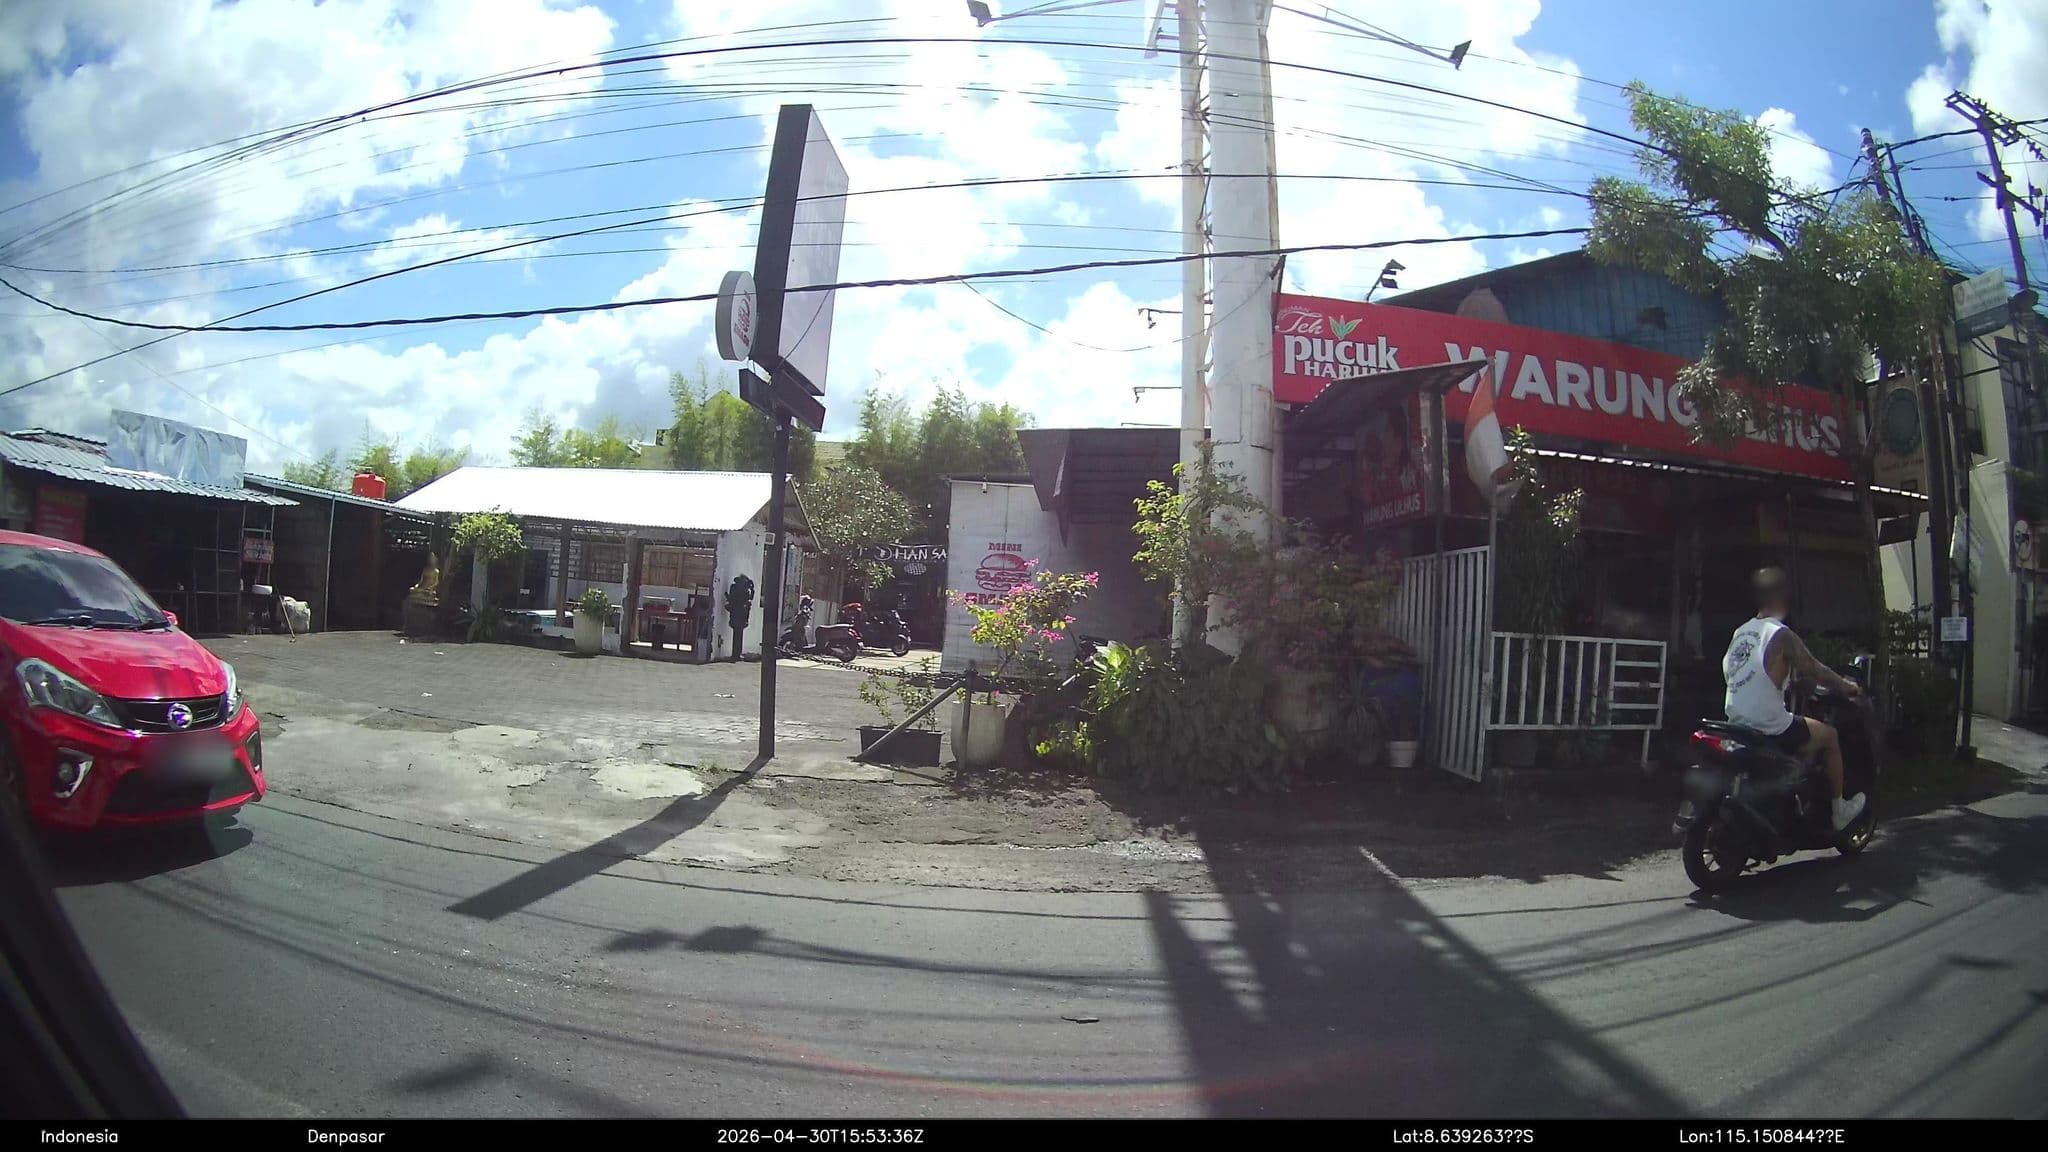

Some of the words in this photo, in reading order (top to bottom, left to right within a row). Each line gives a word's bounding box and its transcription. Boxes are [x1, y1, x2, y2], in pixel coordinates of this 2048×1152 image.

[1275, 310, 1323, 335] Teh
[1283, 334, 1400, 375] pucuk
[1444, 342, 1699, 428] WARUNG
[988, 542, 1022, 552] MINI
